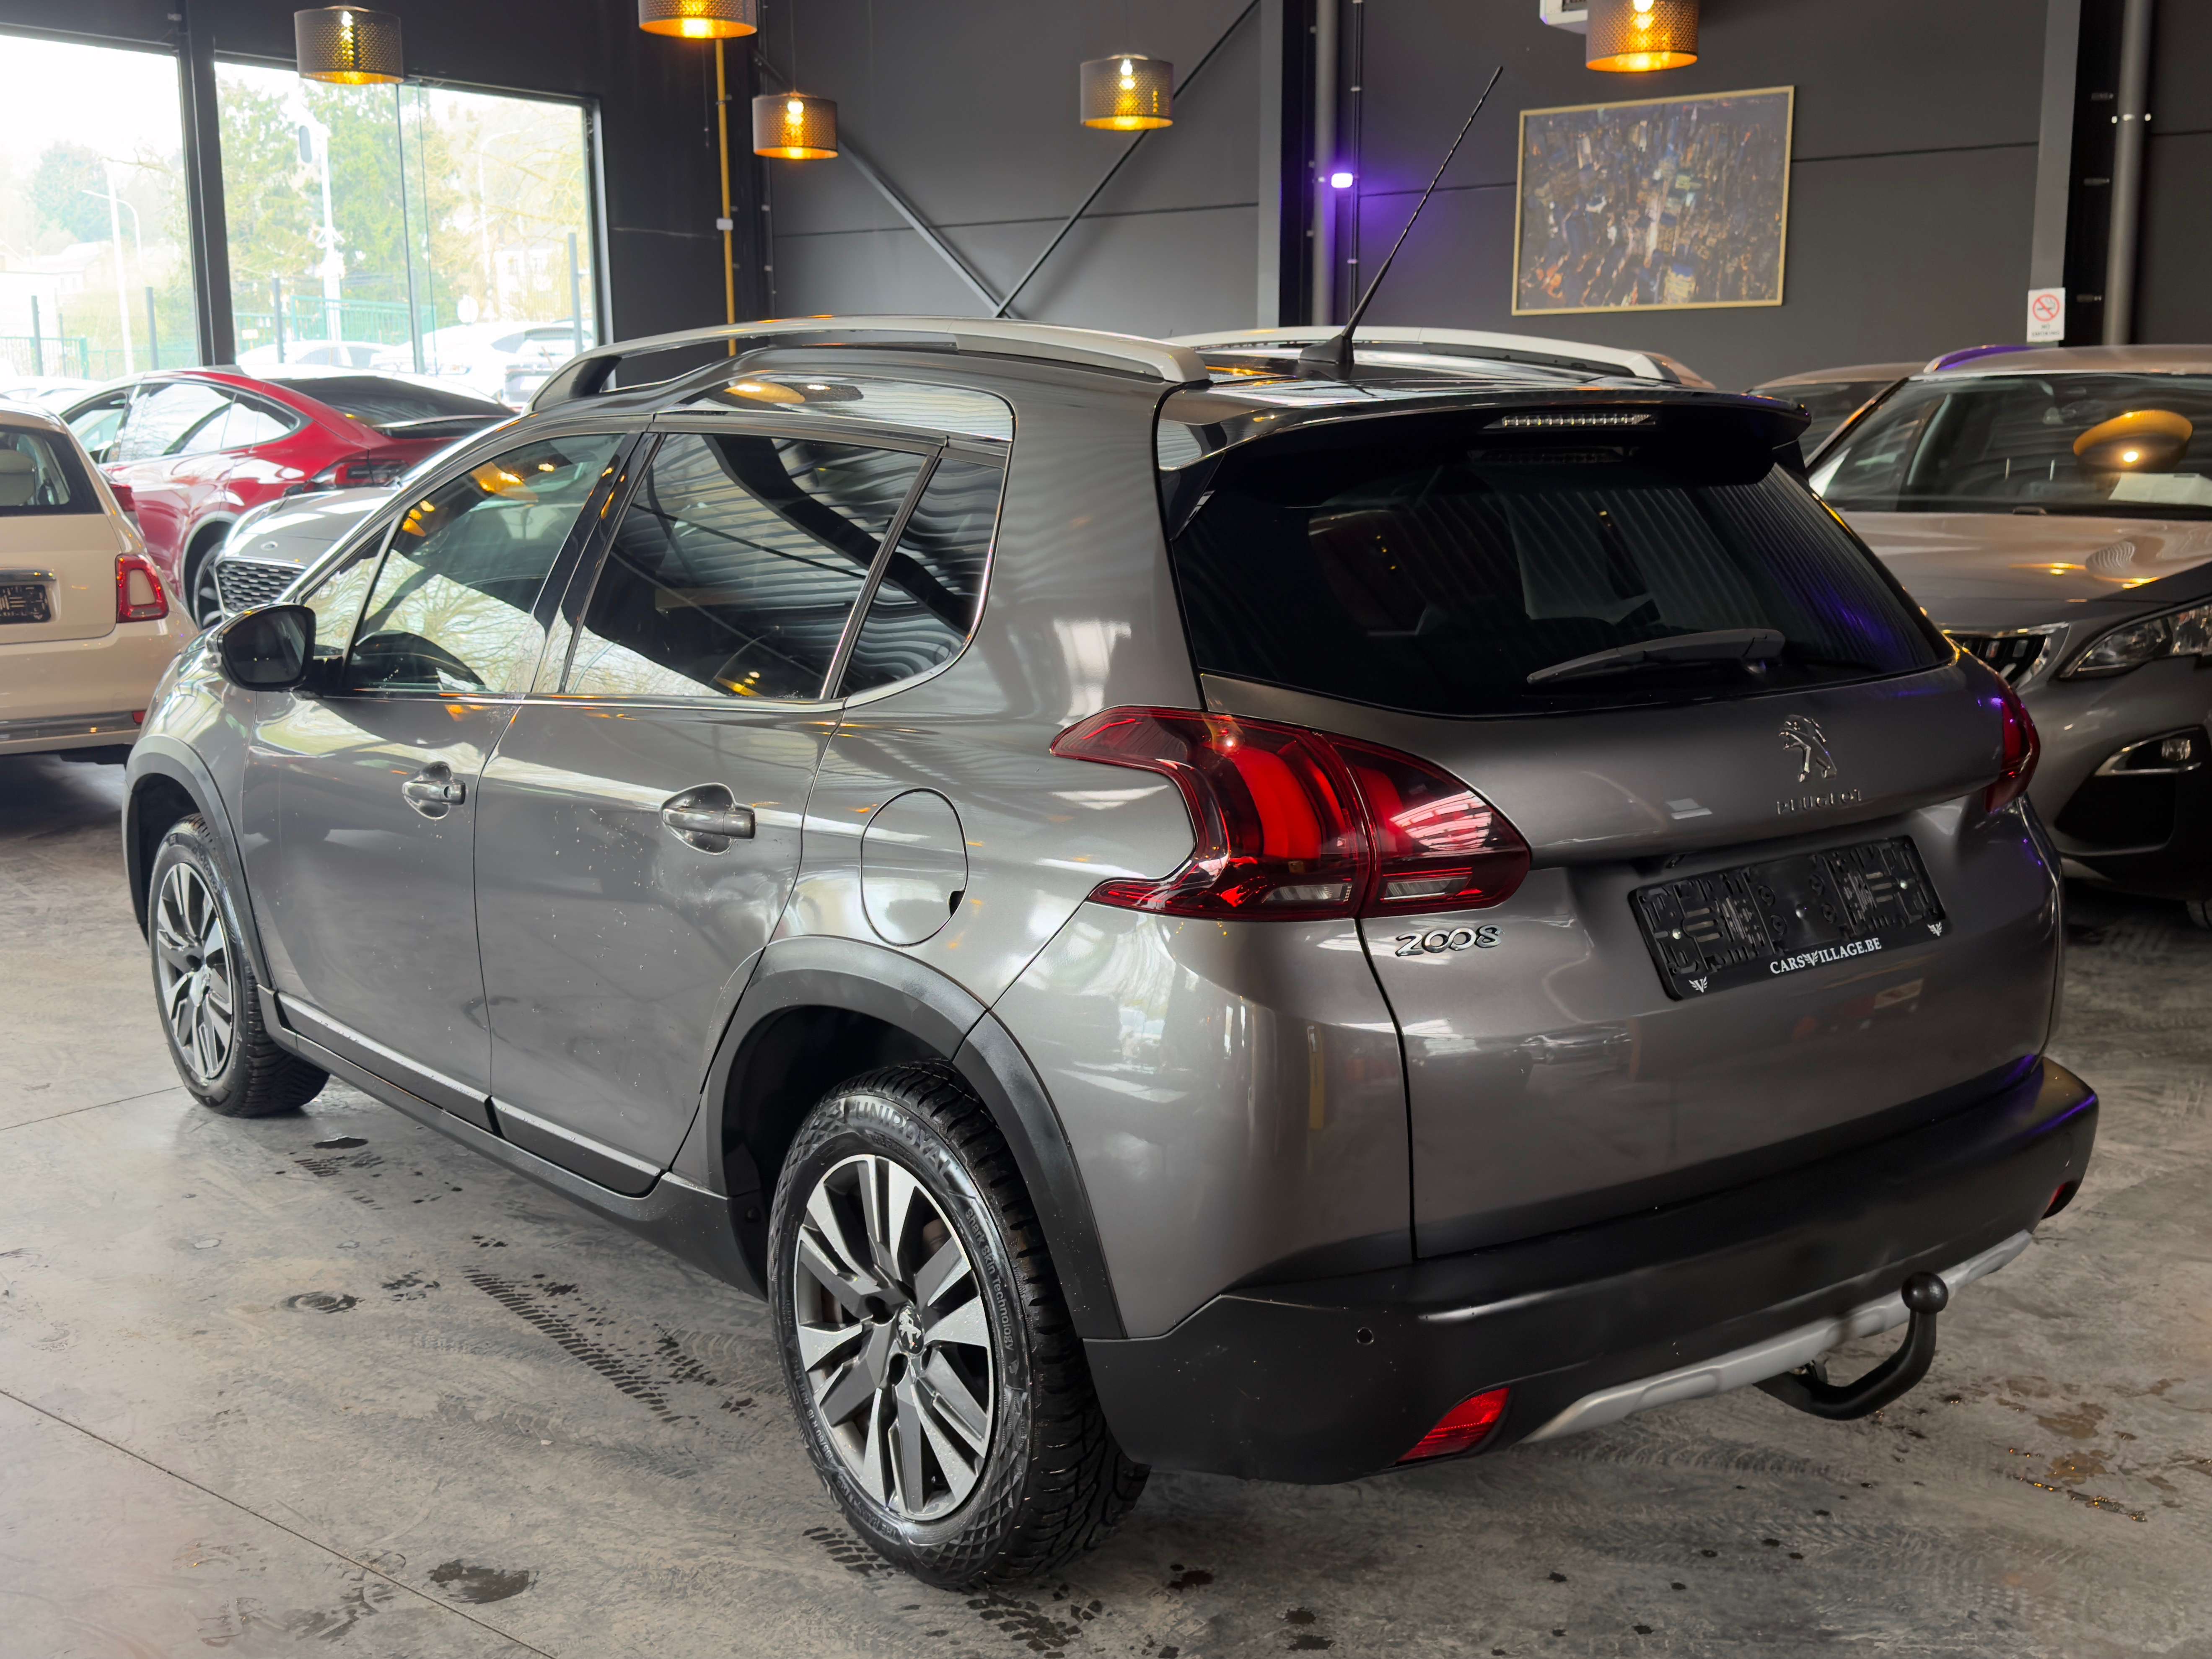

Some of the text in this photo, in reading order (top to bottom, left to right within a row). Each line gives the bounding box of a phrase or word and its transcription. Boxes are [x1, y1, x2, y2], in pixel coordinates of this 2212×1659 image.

[1395, 924, 1504, 957] 2008
[1770, 937, 1882, 974] CARSVILLAGE.BE
[855, 1100, 951, 1180] UNIROYAL
[965, 1208, 1014, 1351] Shark Skin Technology
